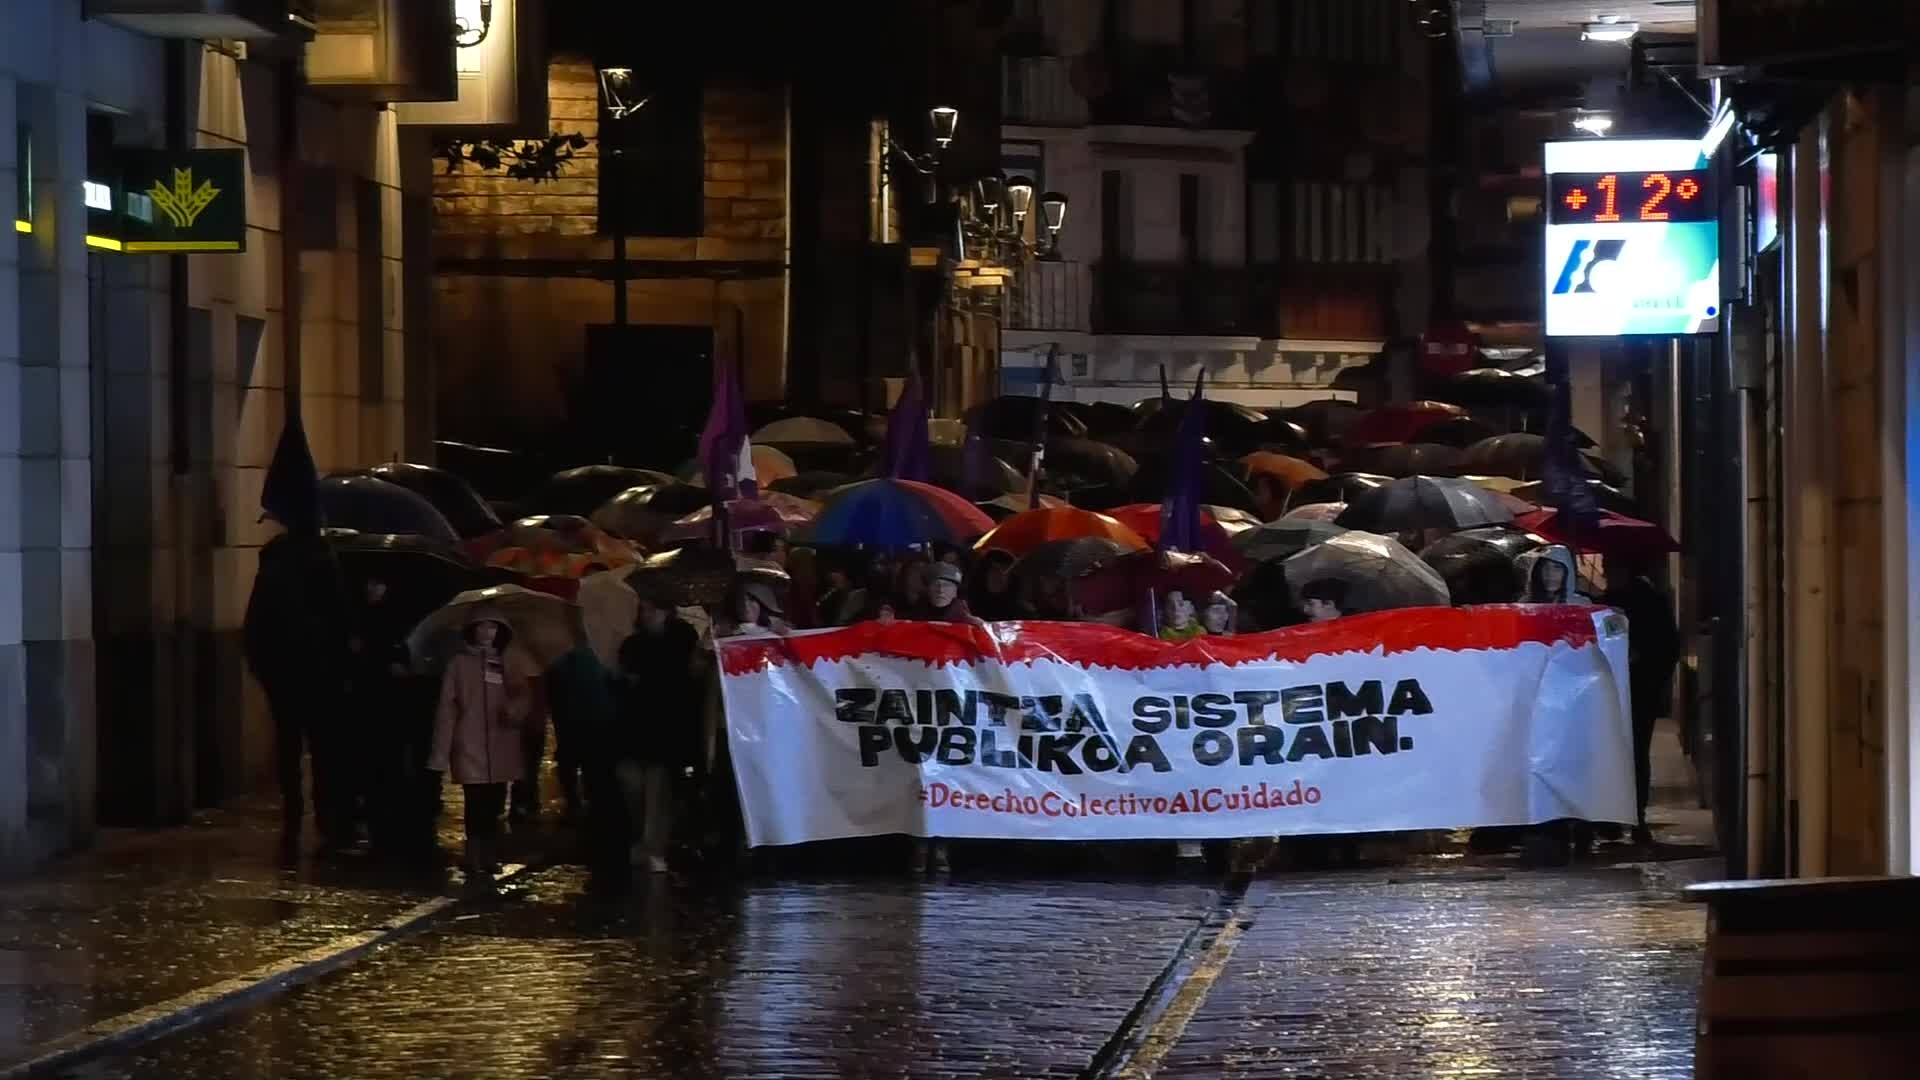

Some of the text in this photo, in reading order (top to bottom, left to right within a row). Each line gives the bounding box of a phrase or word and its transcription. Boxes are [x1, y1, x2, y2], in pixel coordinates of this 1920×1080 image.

[834, 679, 1434, 734] ZAINTZA SISTEMA
[858, 715, 1414, 775] PUBLIKOA ORAIN.
[918, 779, 1321, 817] #DerechoColectivoAlCuidado
